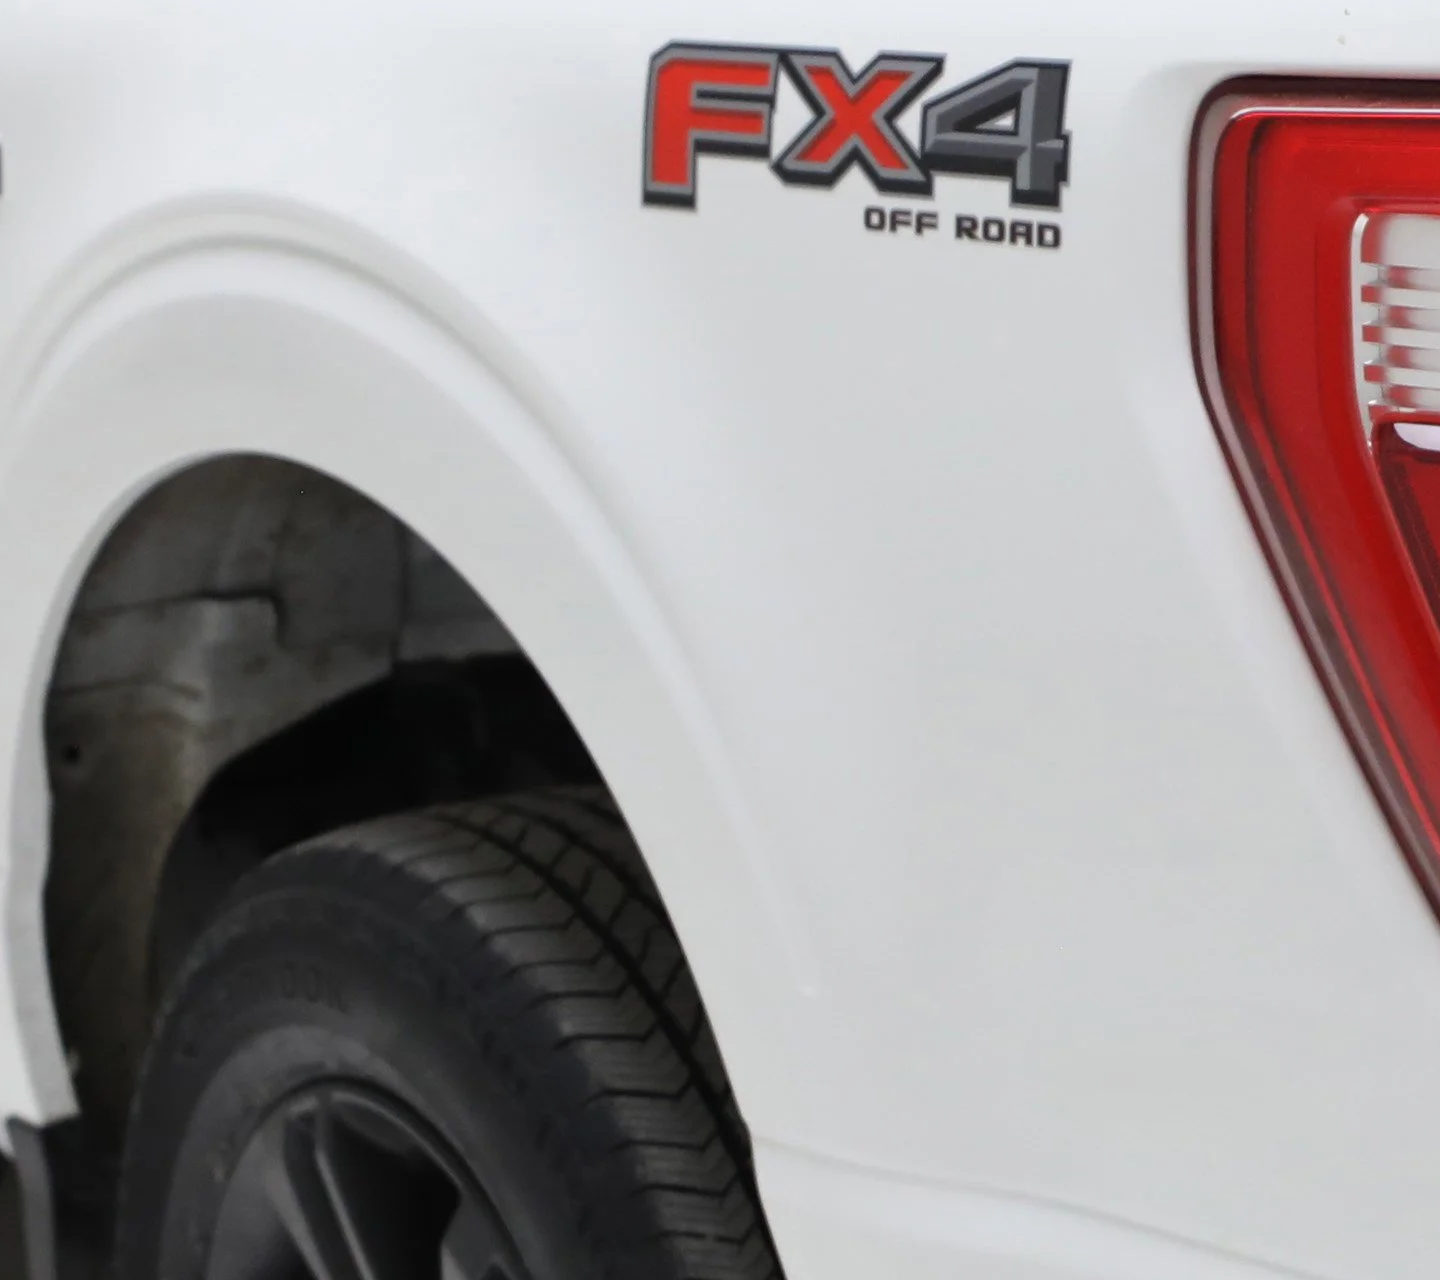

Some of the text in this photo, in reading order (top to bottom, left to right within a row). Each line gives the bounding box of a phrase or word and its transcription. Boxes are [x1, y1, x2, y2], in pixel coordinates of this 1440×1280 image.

[641, 38, 1073, 212] FX4
[863, 206, 1062, 249] OFF ROAD
